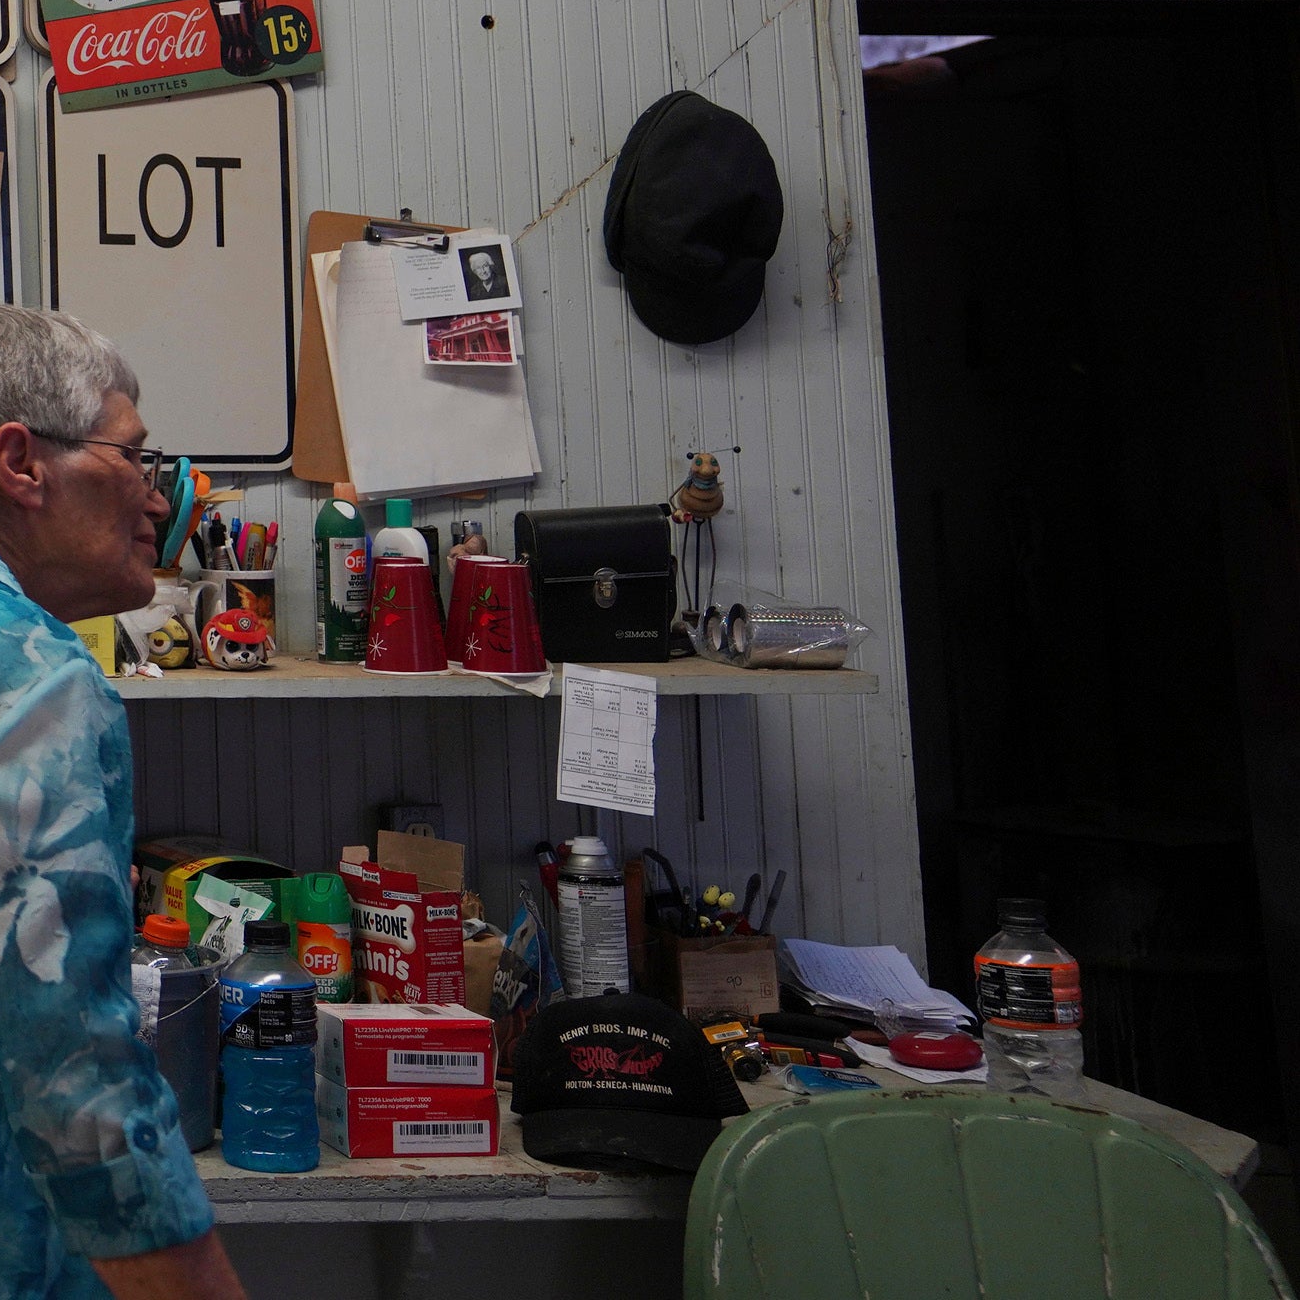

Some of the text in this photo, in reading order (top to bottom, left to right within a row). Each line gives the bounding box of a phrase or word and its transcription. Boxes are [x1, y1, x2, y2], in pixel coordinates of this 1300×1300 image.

[66, 6, 208, 76] Coca-Cola
[115, 77, 188, 98] IN BOTTLES
[99, 152, 242, 248] LOT
[624, 630, 658, 638] SIMMONS
[165, 884, 182, 900] VALUE
[303, 953, 338, 971] OFF!
[316, 978, 334, 986] EEP
[726, 976, 742, 988] 90
[404, 985, 421, 1000] MEATY
[559, 1024, 671, 1050] HENRY BROS. IMP. INC.
